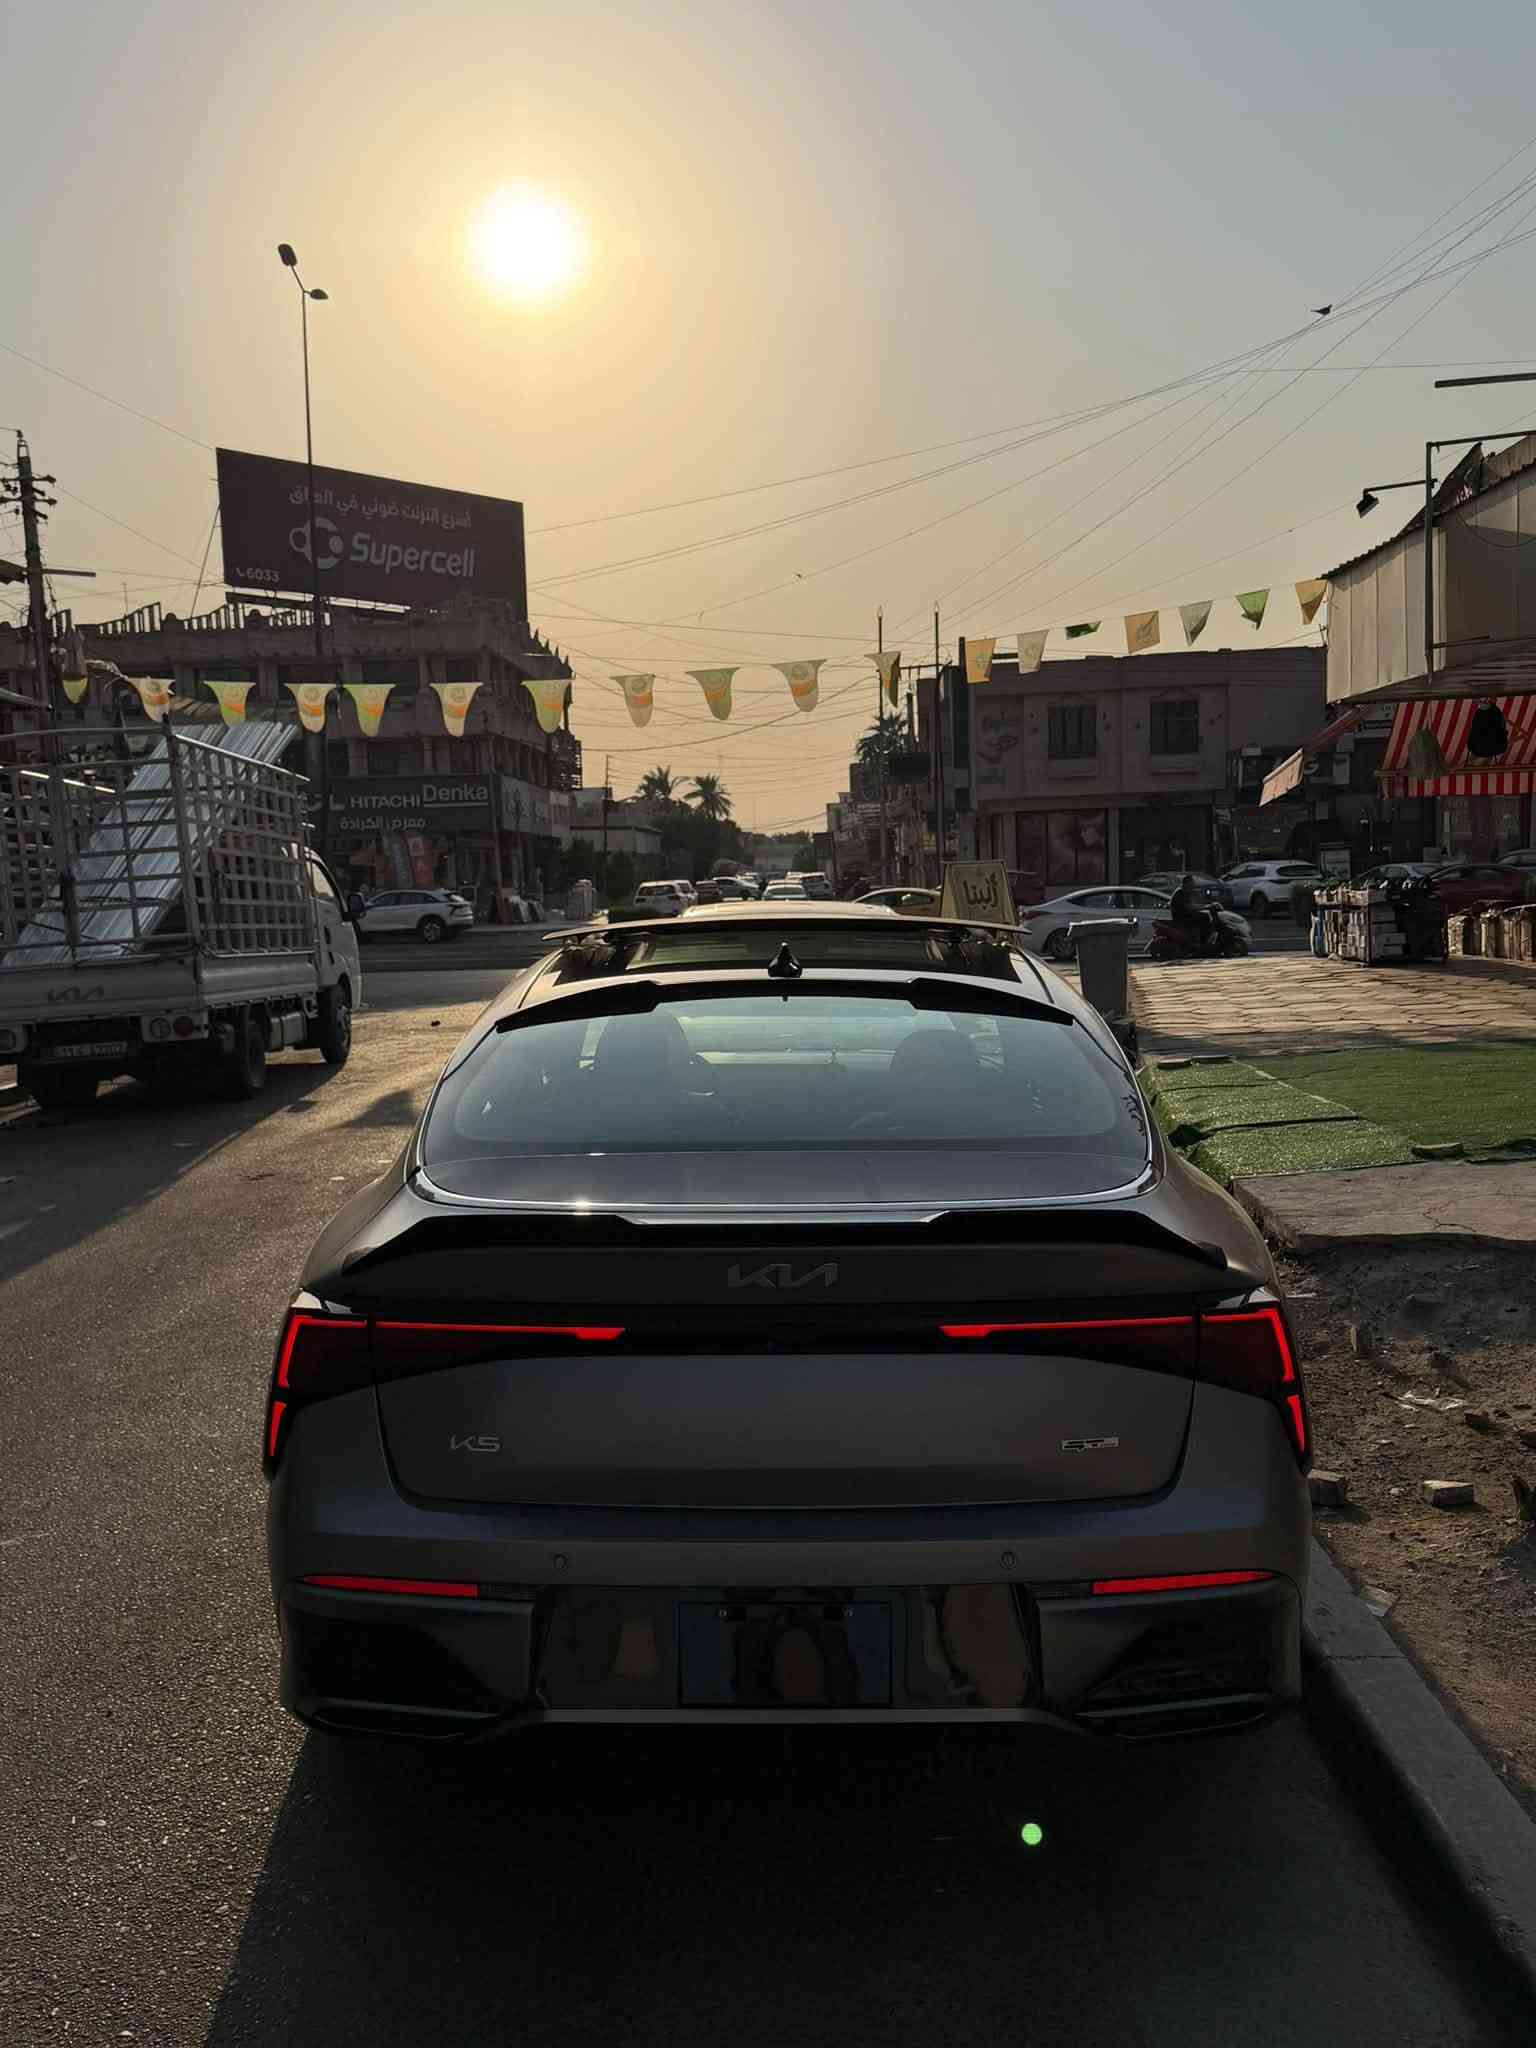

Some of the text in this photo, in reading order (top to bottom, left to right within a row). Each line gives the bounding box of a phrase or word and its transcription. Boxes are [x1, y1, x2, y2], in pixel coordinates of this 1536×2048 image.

[288, 485, 334, 506] العاق
[335, 494, 360, 518] في
[349, 531, 476, 577] Supercell
[246, 567, 281, 583] 6033
[349, 793, 421, 809] HITACHI
[423, 783, 489, 802] Denka
[728, 1263, 839, 1288] KIA
[450, 1434, 501, 1453] K5
